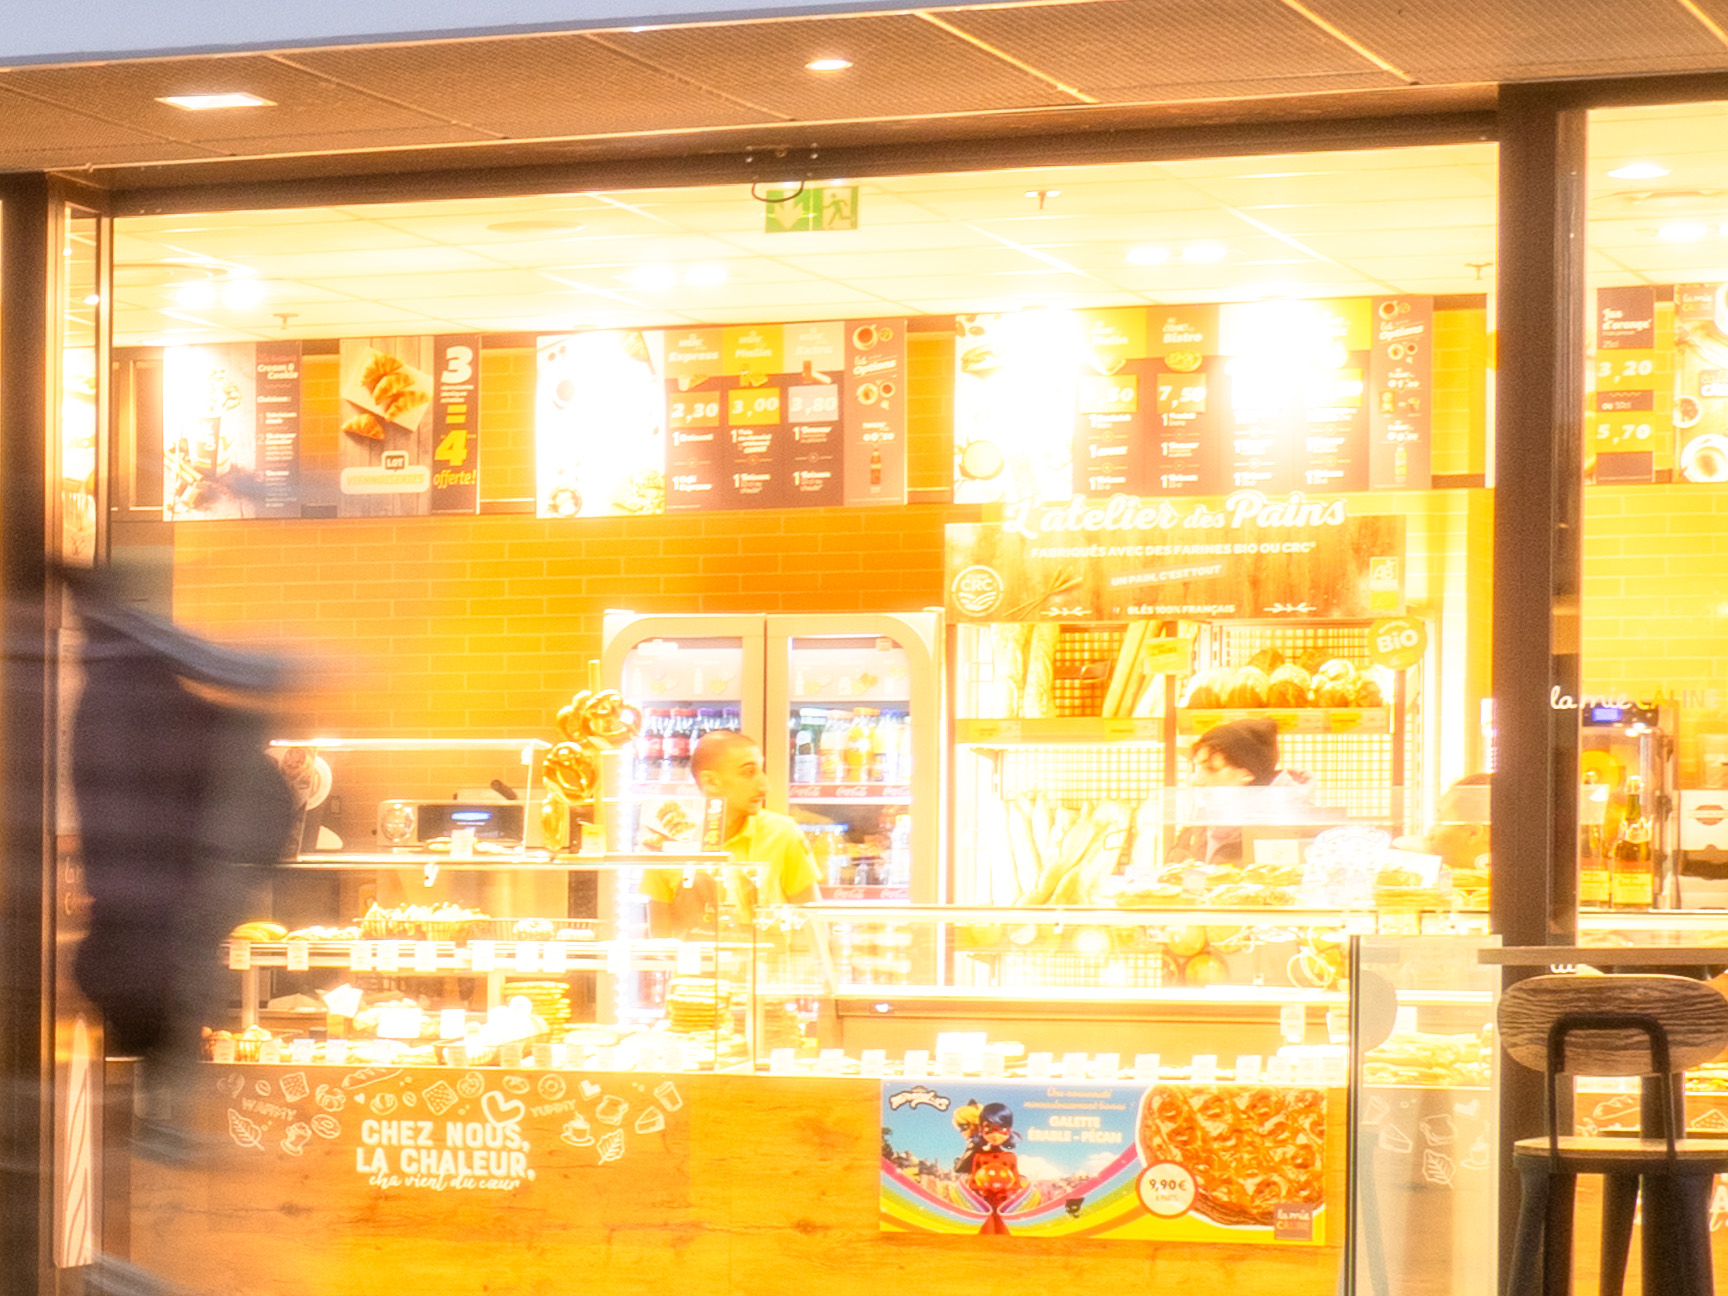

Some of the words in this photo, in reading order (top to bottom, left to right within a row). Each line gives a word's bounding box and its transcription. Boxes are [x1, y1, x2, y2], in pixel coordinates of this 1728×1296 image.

[1163, 333, 1204, 344] Bistro
[441, 345, 473, 384] 3
[668, 351, 719, 363] Express
[1597, 359, 1652, 384] 3,20
[670, 402, 720, 423] 2,30
[731, 396, 780, 418] 3,00
[1596, 423, 1651, 445] 5,70
[434, 429, 468, 466] 4
[386, 457, 405, 467] LOT
[432, 469, 477, 490] offerte!
[1002, 491, 1181, 541] L'atelier
[1182, 503, 1225, 529] des
[1225, 488, 1348, 529] Pains
[1107, 545, 1144, 557] AVEC
[1146, 545, 1172, 557] DES
[1173, 543, 1232, 556] FARINES
[1233, 542, 1258, 555] BIO
[1259, 542, 1280, 554] OU
[960, 578, 993, 591] CRC
[1550, 685, 1578, 710] la
[1578, 687, 1632, 710] mie
[1048, 1115, 1101, 1128] GALETTE
[360, 1119, 434, 1147] CHEZ
[445, 1121, 532, 1153] NOUS,
[355, 1147, 390, 1174] LA
[399, 1147, 537, 1182] CHALEUR,
[369, 1171, 402, 1190] cha
[404, 1173, 448, 1191] vient
[449, 1173, 477, 1190] du
